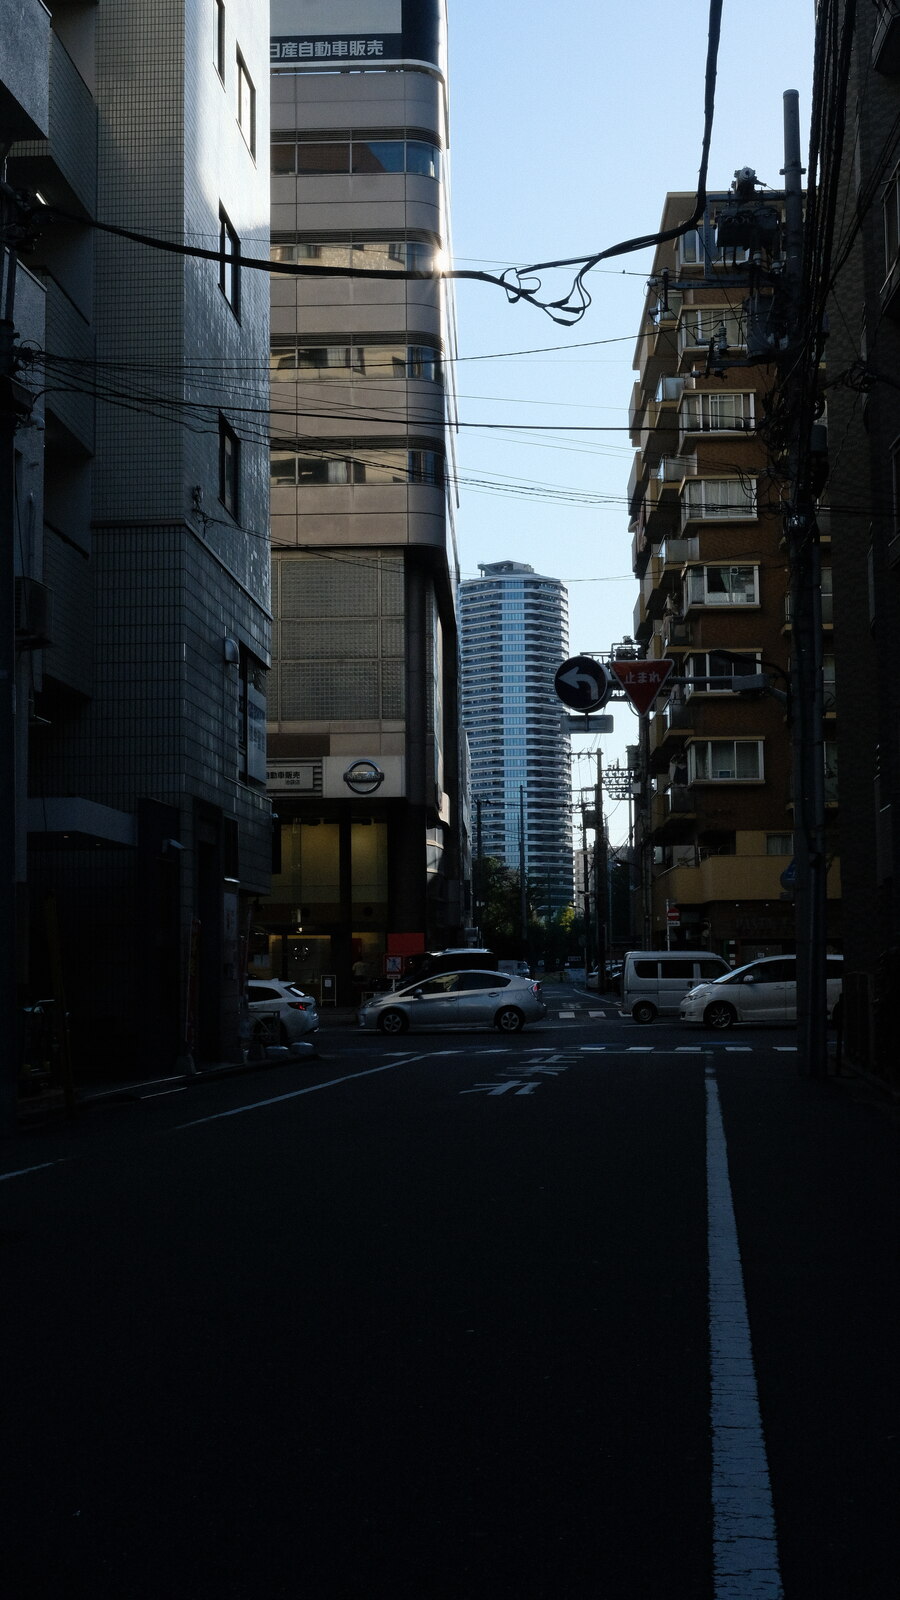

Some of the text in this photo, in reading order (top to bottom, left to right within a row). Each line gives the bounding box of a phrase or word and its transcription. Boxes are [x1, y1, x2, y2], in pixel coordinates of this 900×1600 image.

[270, 40, 384, 58] 日産自動車販売
[624, 671, 661, 684] 止まれ
